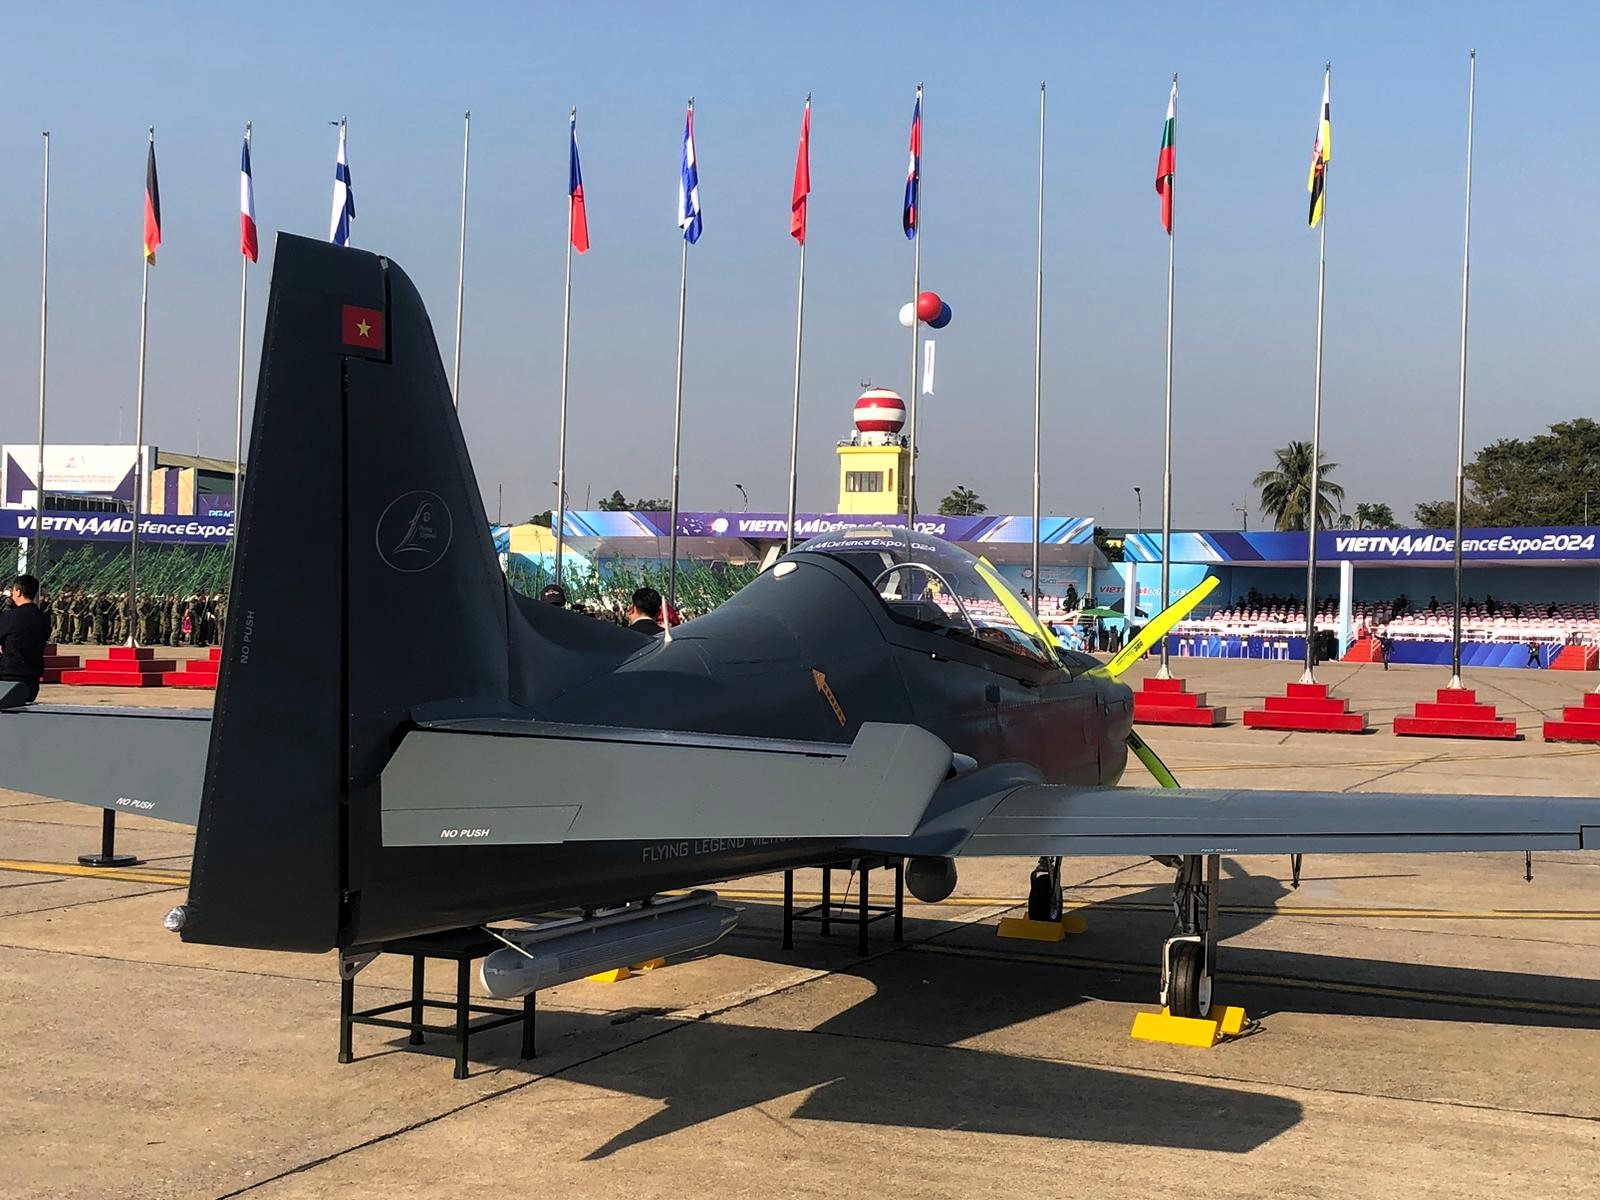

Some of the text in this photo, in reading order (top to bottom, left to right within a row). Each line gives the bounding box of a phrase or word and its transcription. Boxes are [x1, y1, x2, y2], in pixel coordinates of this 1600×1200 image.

[240, 610, 255, 664] NO PUSH
[116, 797, 156, 810] NO PUSH
[440, 828, 490, 838] NO PUSH
[642, 842, 689, 862] FLYING
[694, 838, 746, 855] LEGEND
